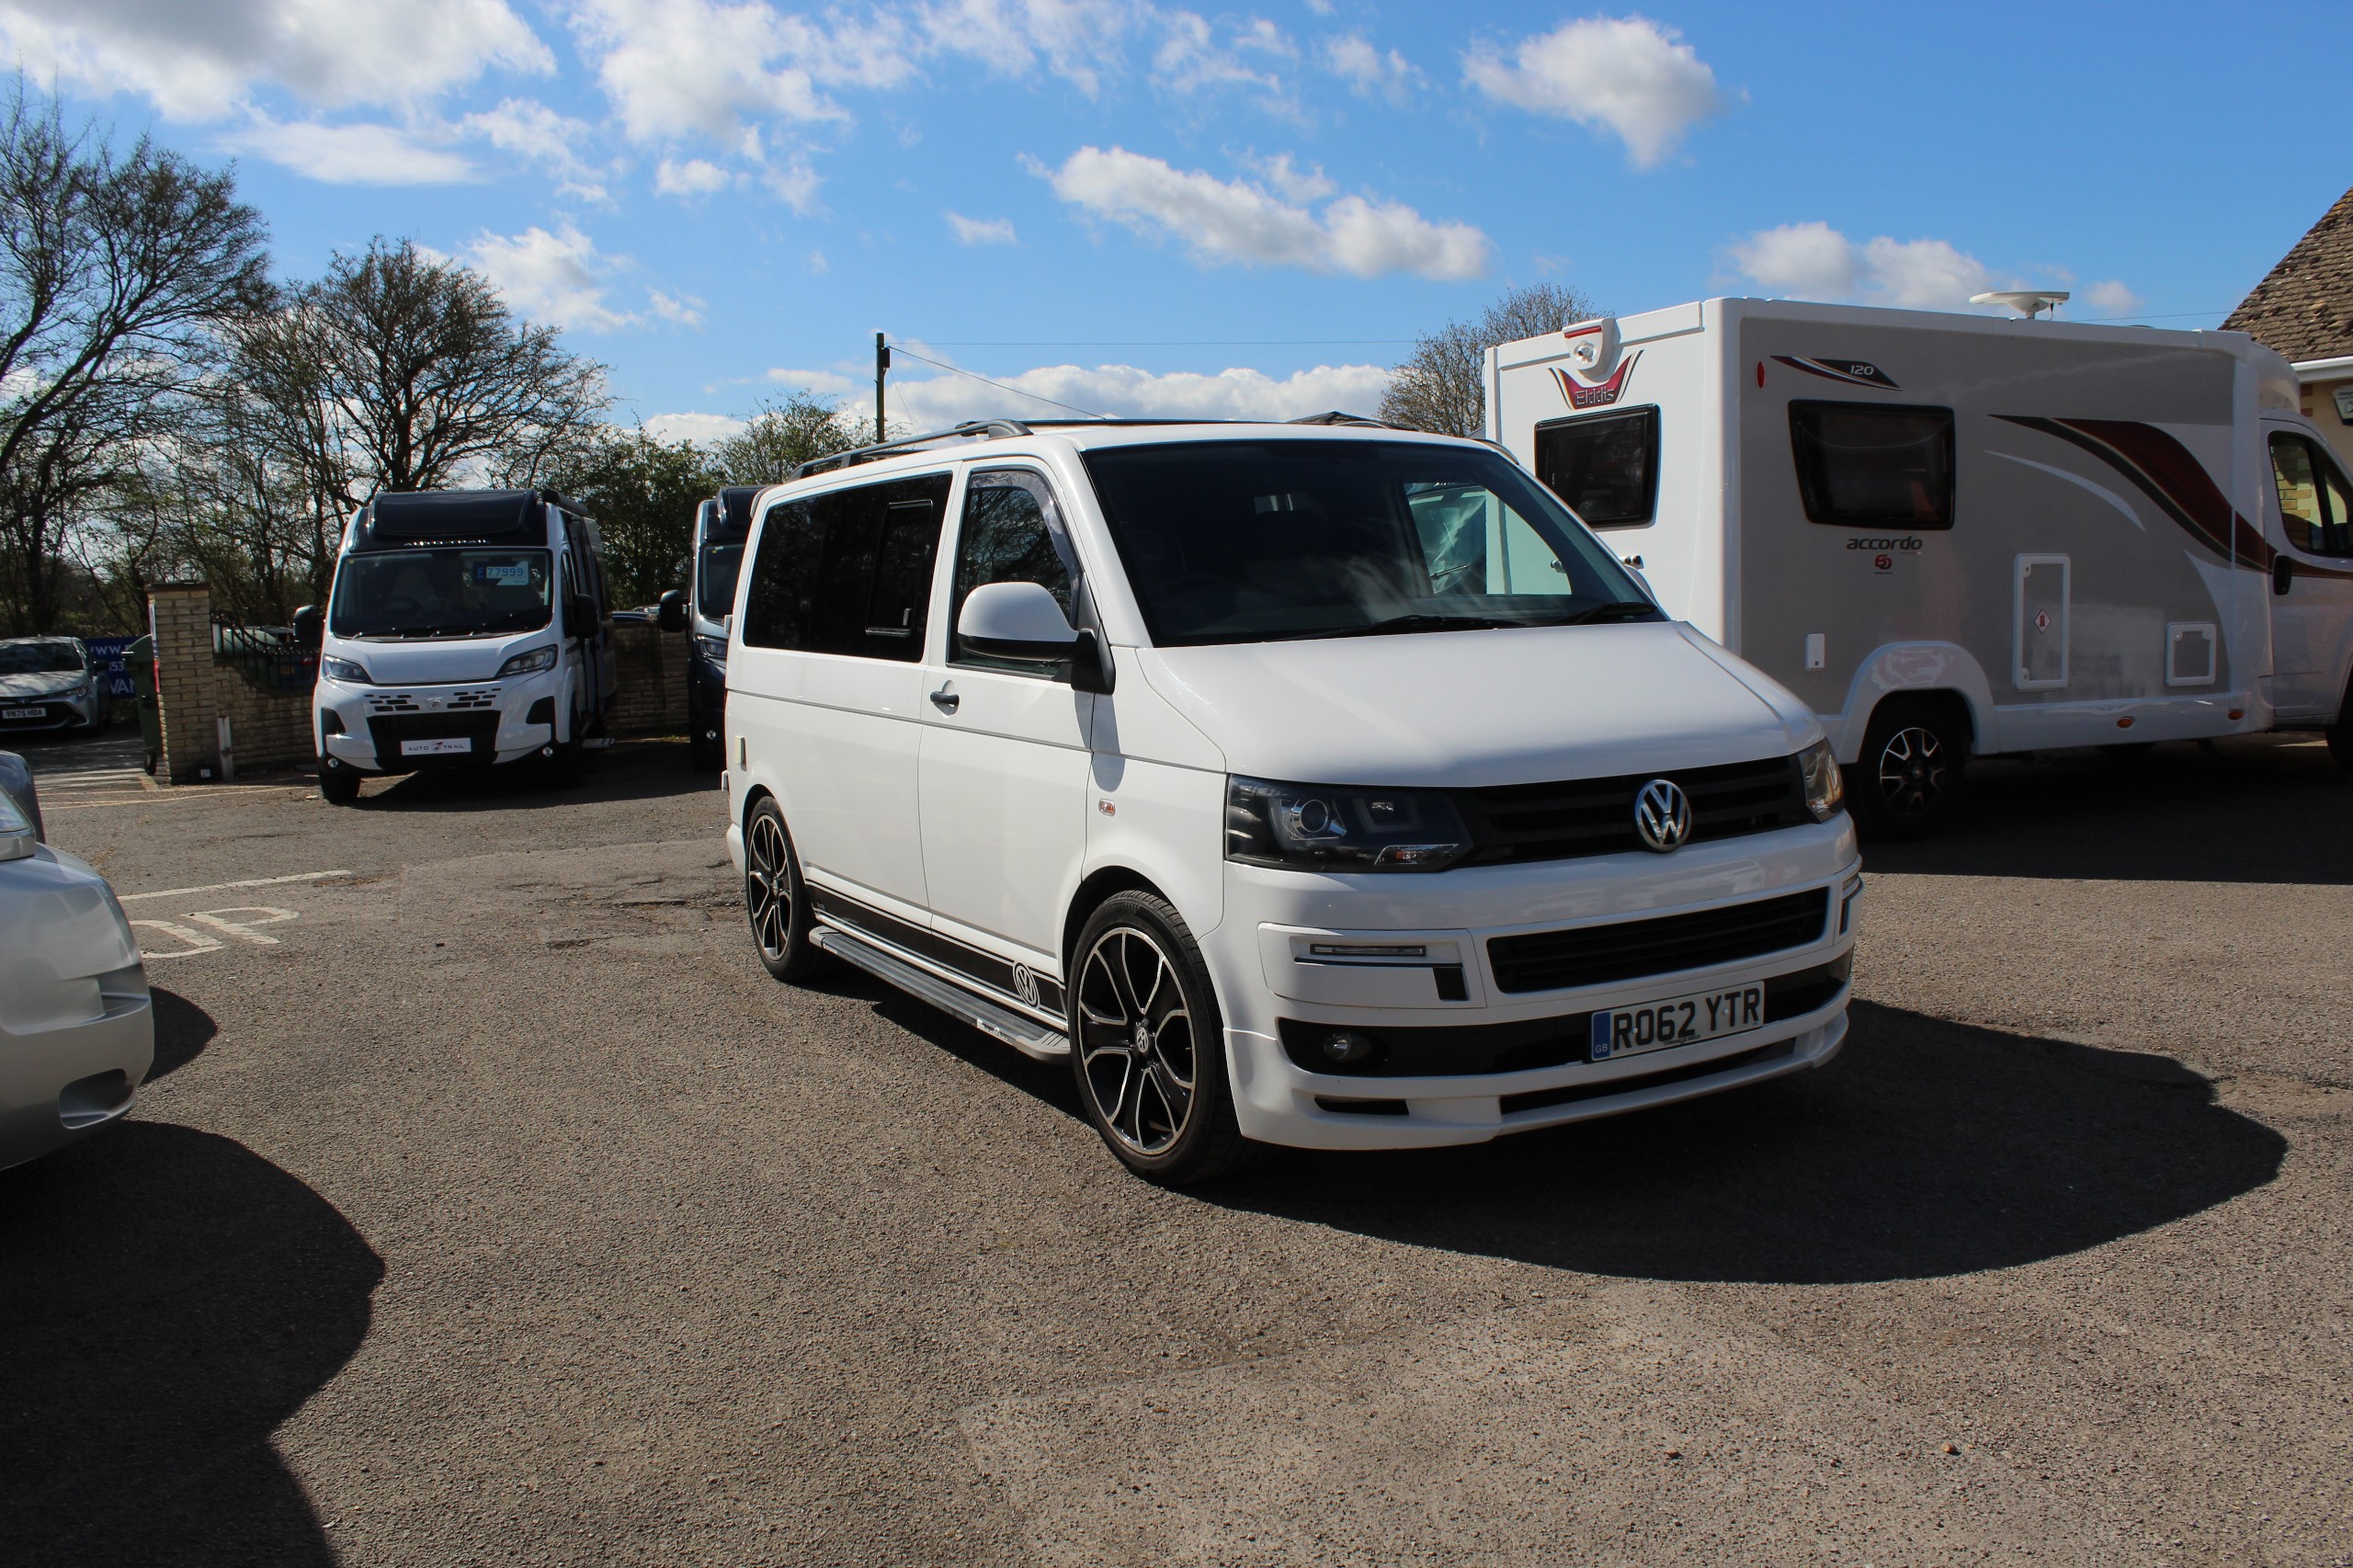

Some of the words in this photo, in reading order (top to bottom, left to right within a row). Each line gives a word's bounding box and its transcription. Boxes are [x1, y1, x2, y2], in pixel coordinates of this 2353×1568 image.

[1850, 365, 1874, 375] 120
[1575, 386, 1615, 405] Elddis
[1847, 536, 1923, 550] accordo
[1613, 1001, 1697, 1051] RO62
[1705, 988, 1761, 1032] YTR
[1595, 1043, 1608, 1053] GB
